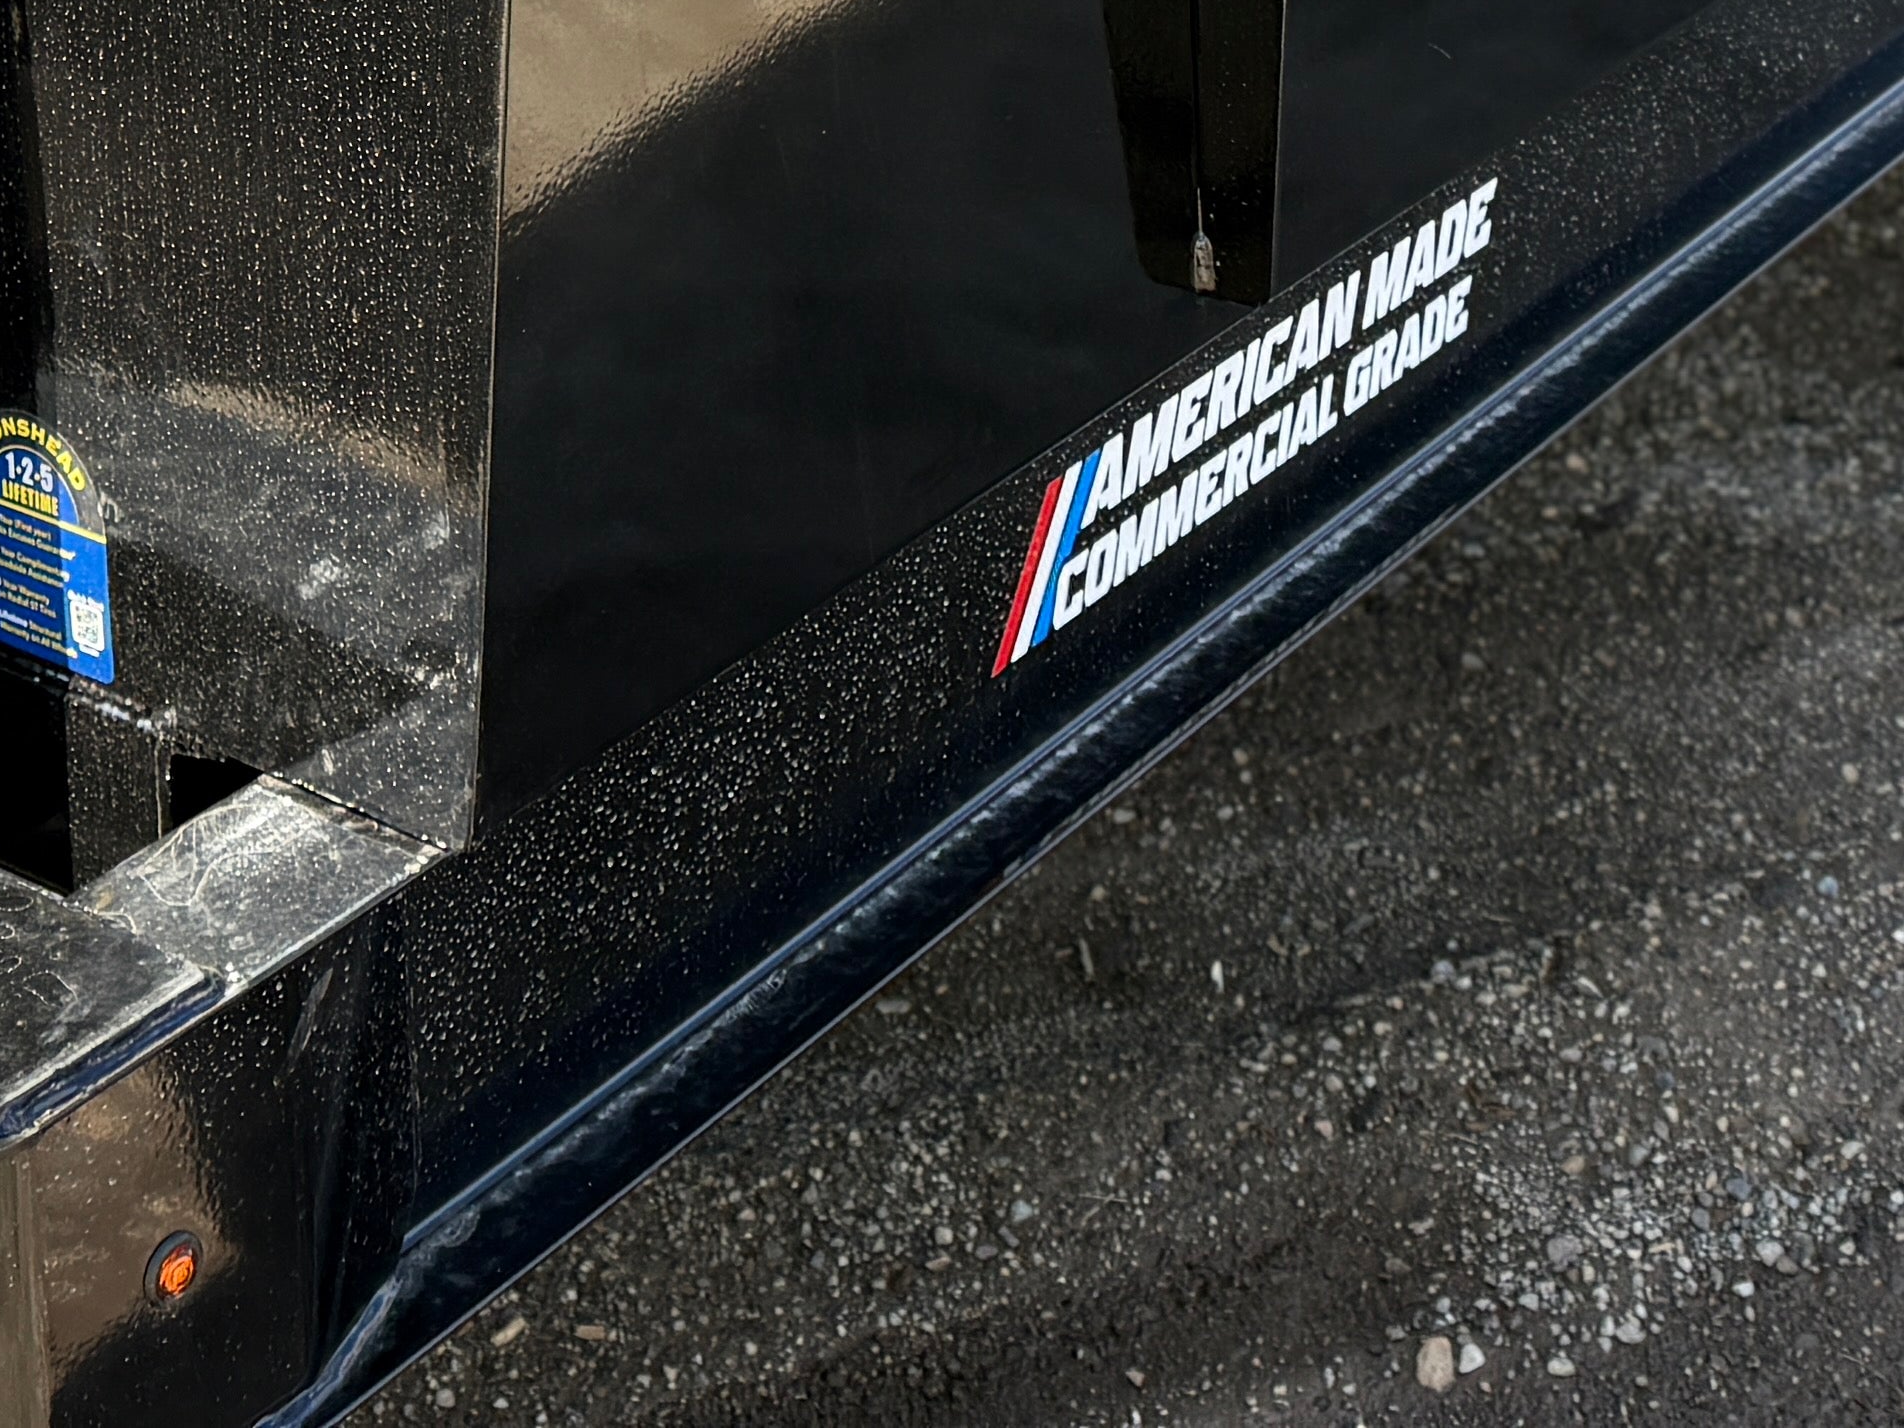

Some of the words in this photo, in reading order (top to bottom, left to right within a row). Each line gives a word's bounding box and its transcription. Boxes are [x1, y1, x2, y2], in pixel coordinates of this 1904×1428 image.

[1, 478, 59, 517] LIFETIME
[1053, 374, 1339, 631] COMMERCIAL
[1344, 274, 1473, 417] GRADE
[1081, 270, 1361, 530] AMERICAN
[1362, 177, 1498, 330] MADE
